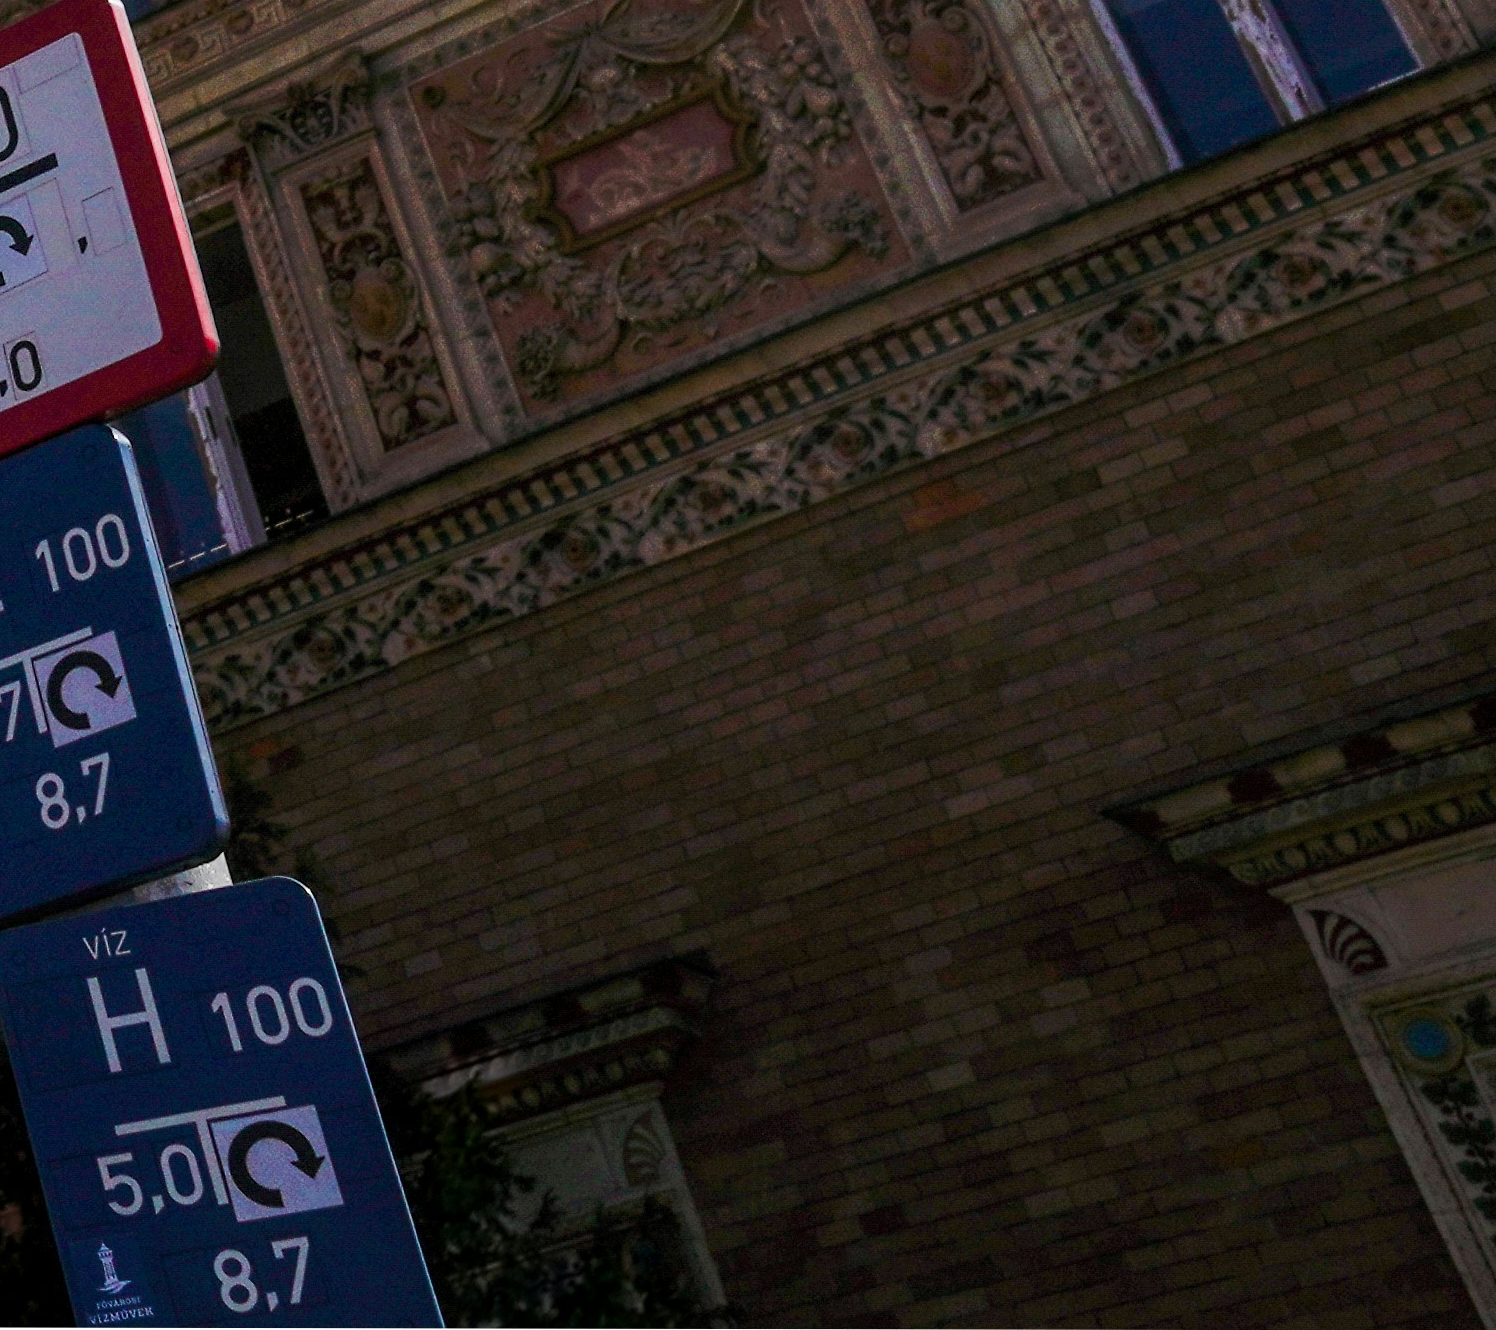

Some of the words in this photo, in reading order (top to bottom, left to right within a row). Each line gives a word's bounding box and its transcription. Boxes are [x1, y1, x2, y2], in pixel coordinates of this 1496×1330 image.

[34, 513, 130, 593] 100
[35, 751, 111, 830] 8,7
[82, 927, 131, 961] VÍZ
[87, 967, 171, 1074] H
[211, 977, 333, 1053] 100
[96, 1143, 204, 1216] 5,0
[213, 1236, 309, 1313] 8,7
